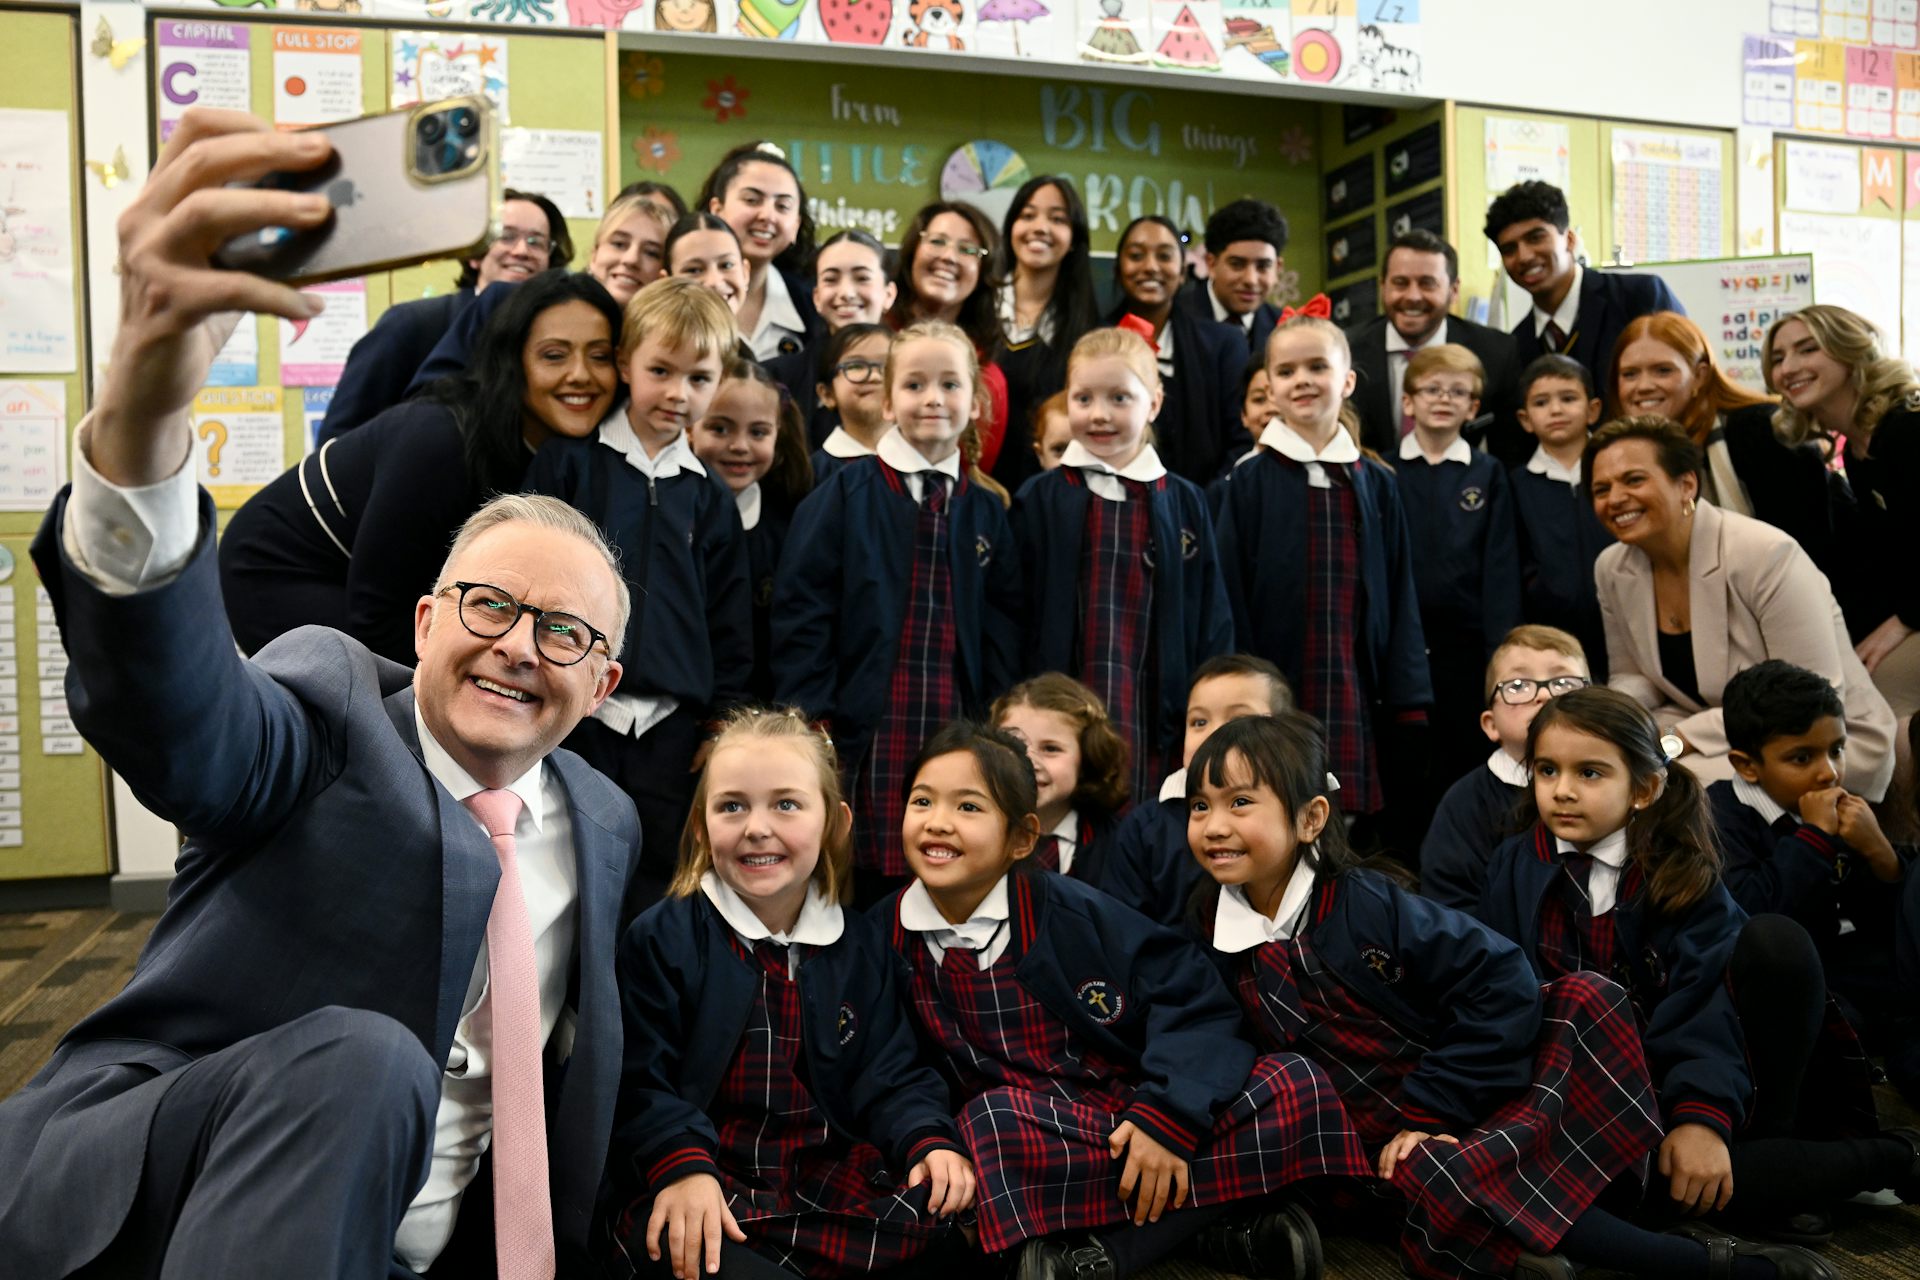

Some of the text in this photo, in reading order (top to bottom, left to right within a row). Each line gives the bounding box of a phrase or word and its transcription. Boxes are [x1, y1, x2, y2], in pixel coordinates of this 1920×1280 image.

[172, 24, 235, 42] CAPITAL
[275, 31, 358, 51] FULL STOP
[161, 61, 199, 105] C
[1861, 49, 1879, 77] 12
[830, 83, 900, 127] from
[1039, 84, 1258, 169] BIG things
[787, 138, 930, 187] ITTLE
[1867, 155, 1892, 188] M
[808, 196, 899, 241] things
[1057, 172, 1215, 236] ROW
[200, 391, 276, 407] QUESTION
